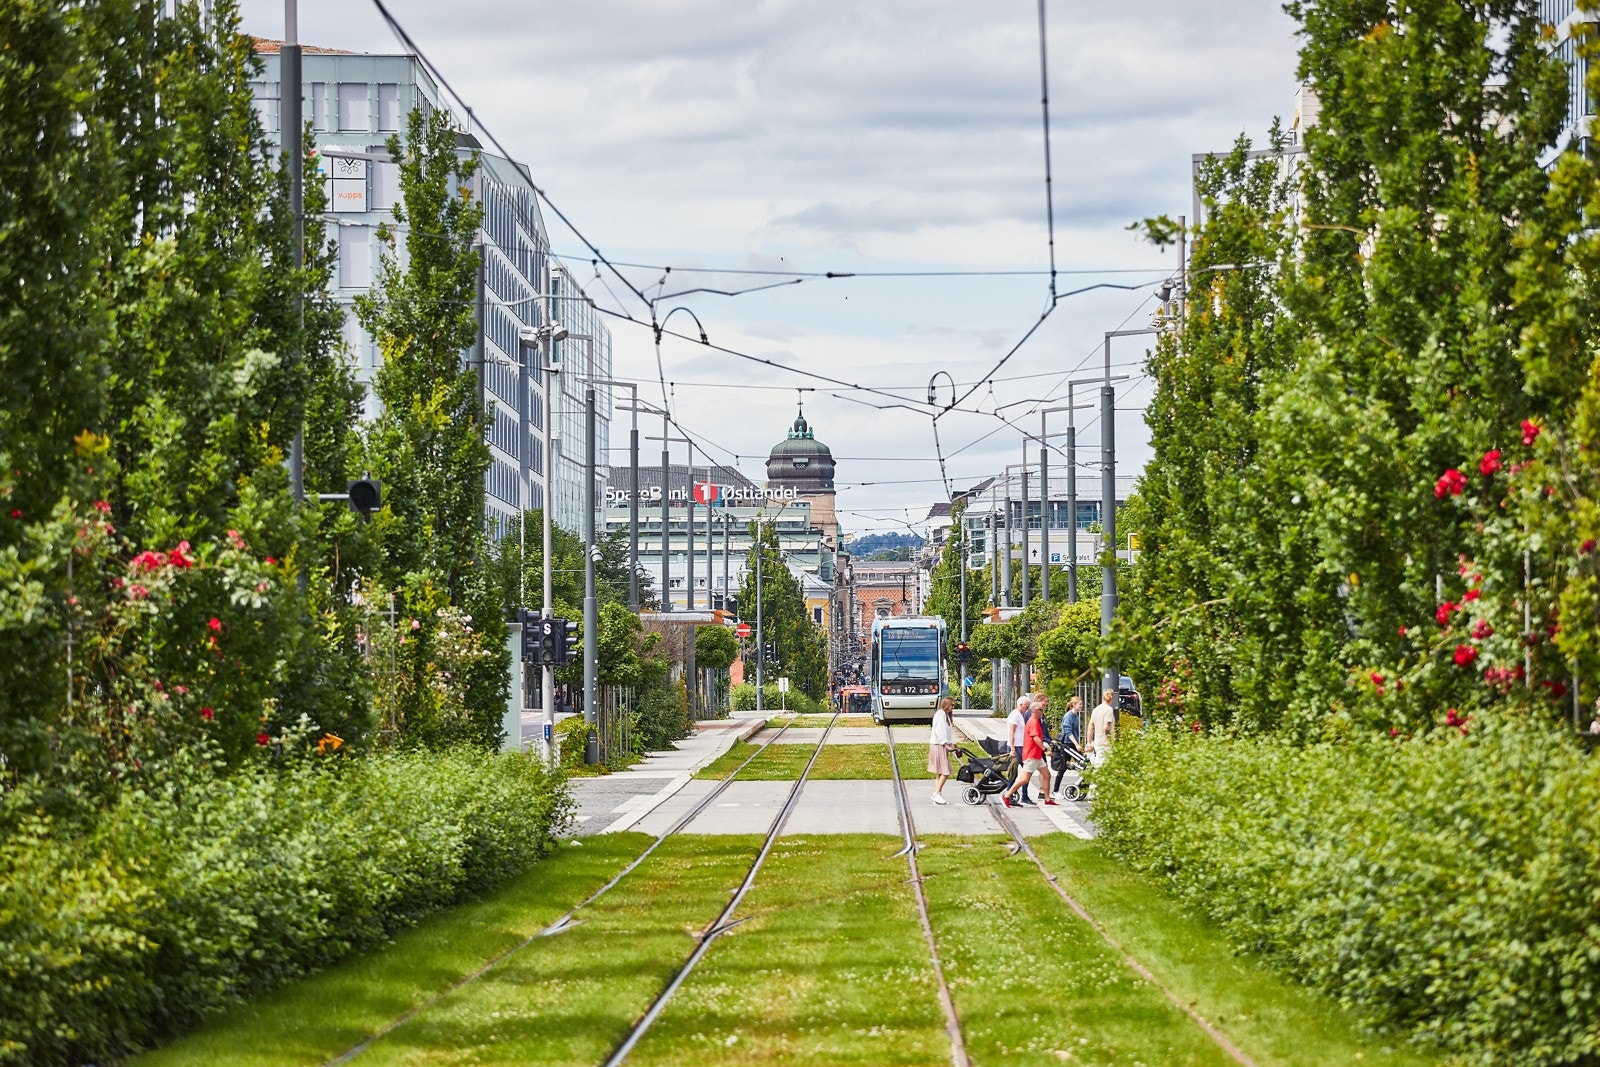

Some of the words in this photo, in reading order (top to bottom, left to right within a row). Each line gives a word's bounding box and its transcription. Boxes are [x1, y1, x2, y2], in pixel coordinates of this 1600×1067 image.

[606, 486, 690, 503] SpaeBnk
[700, 485, 711, 501] 1
[543, 623, 551, 635] S
